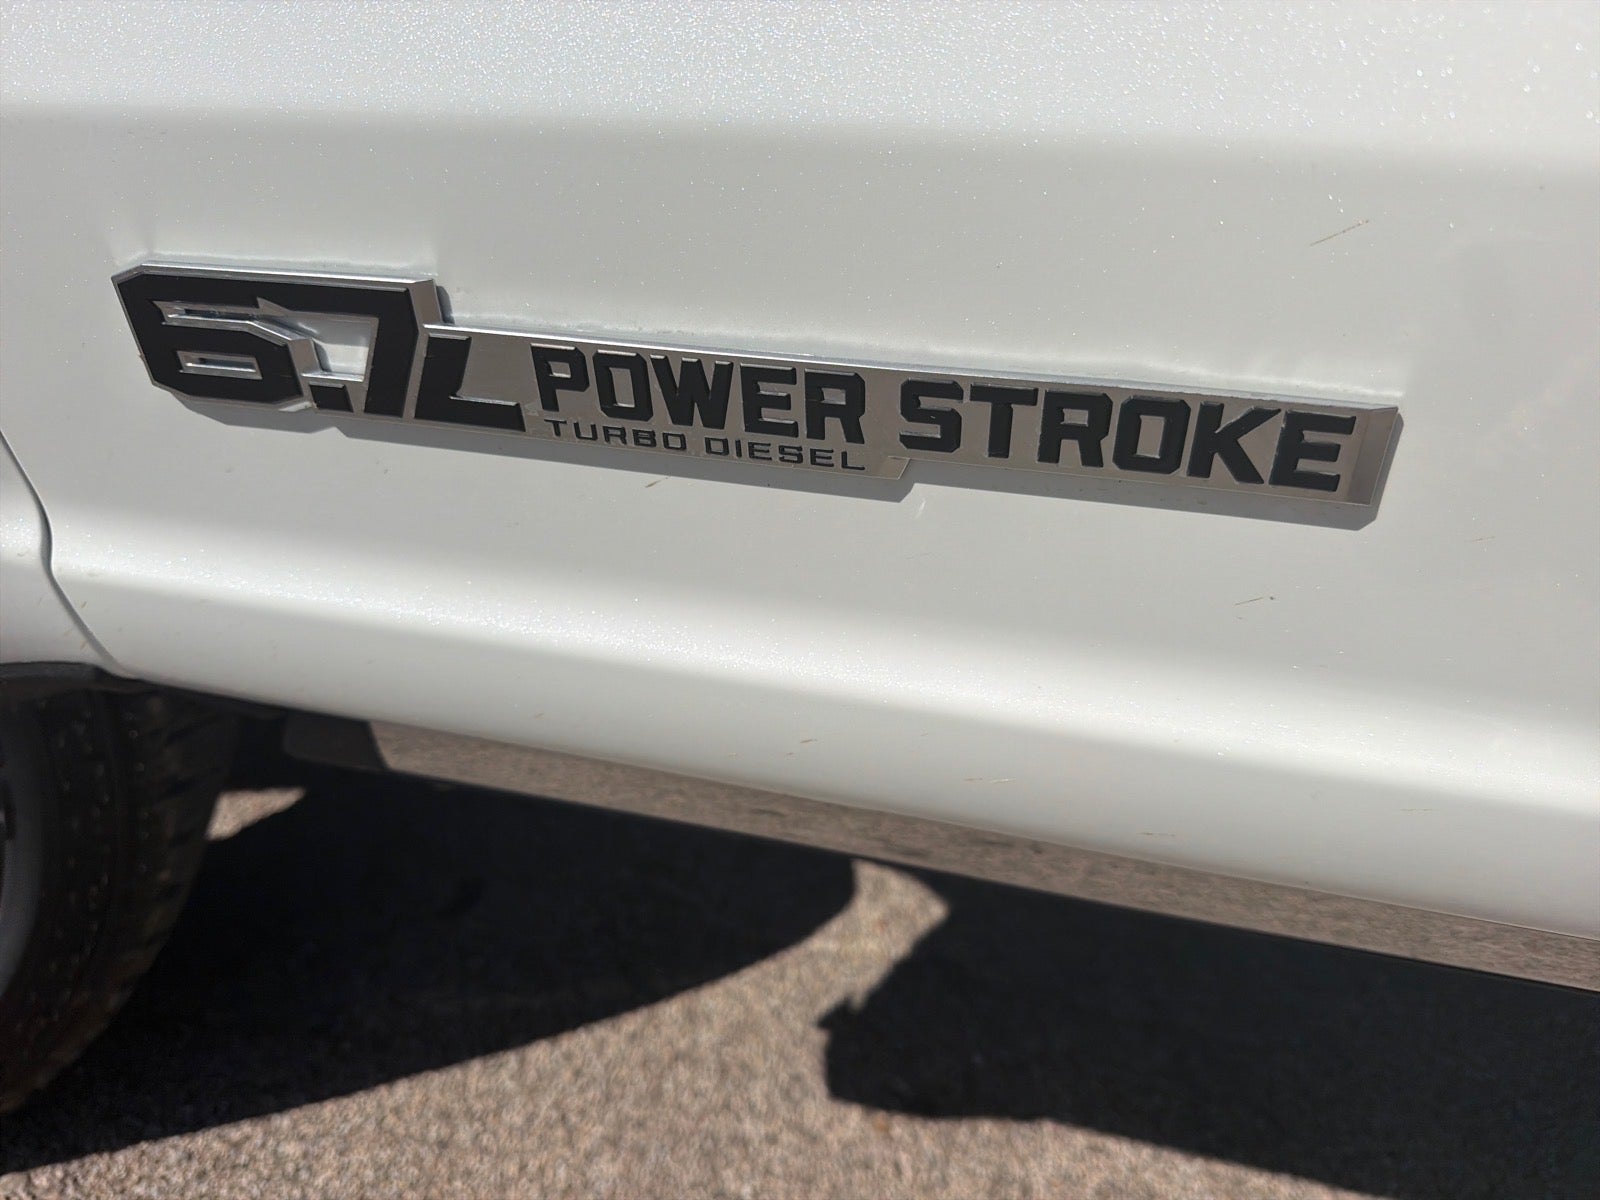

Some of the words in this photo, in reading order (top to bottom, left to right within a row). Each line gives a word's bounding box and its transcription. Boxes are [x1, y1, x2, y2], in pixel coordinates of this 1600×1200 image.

[115, 269, 526, 432] 6.7L
[530, 343, 866, 444] POWER
[899, 377, 1356, 492] STROKE
[544, 418, 687, 451] TURBO
[704, 436, 866, 471] DIESEL
